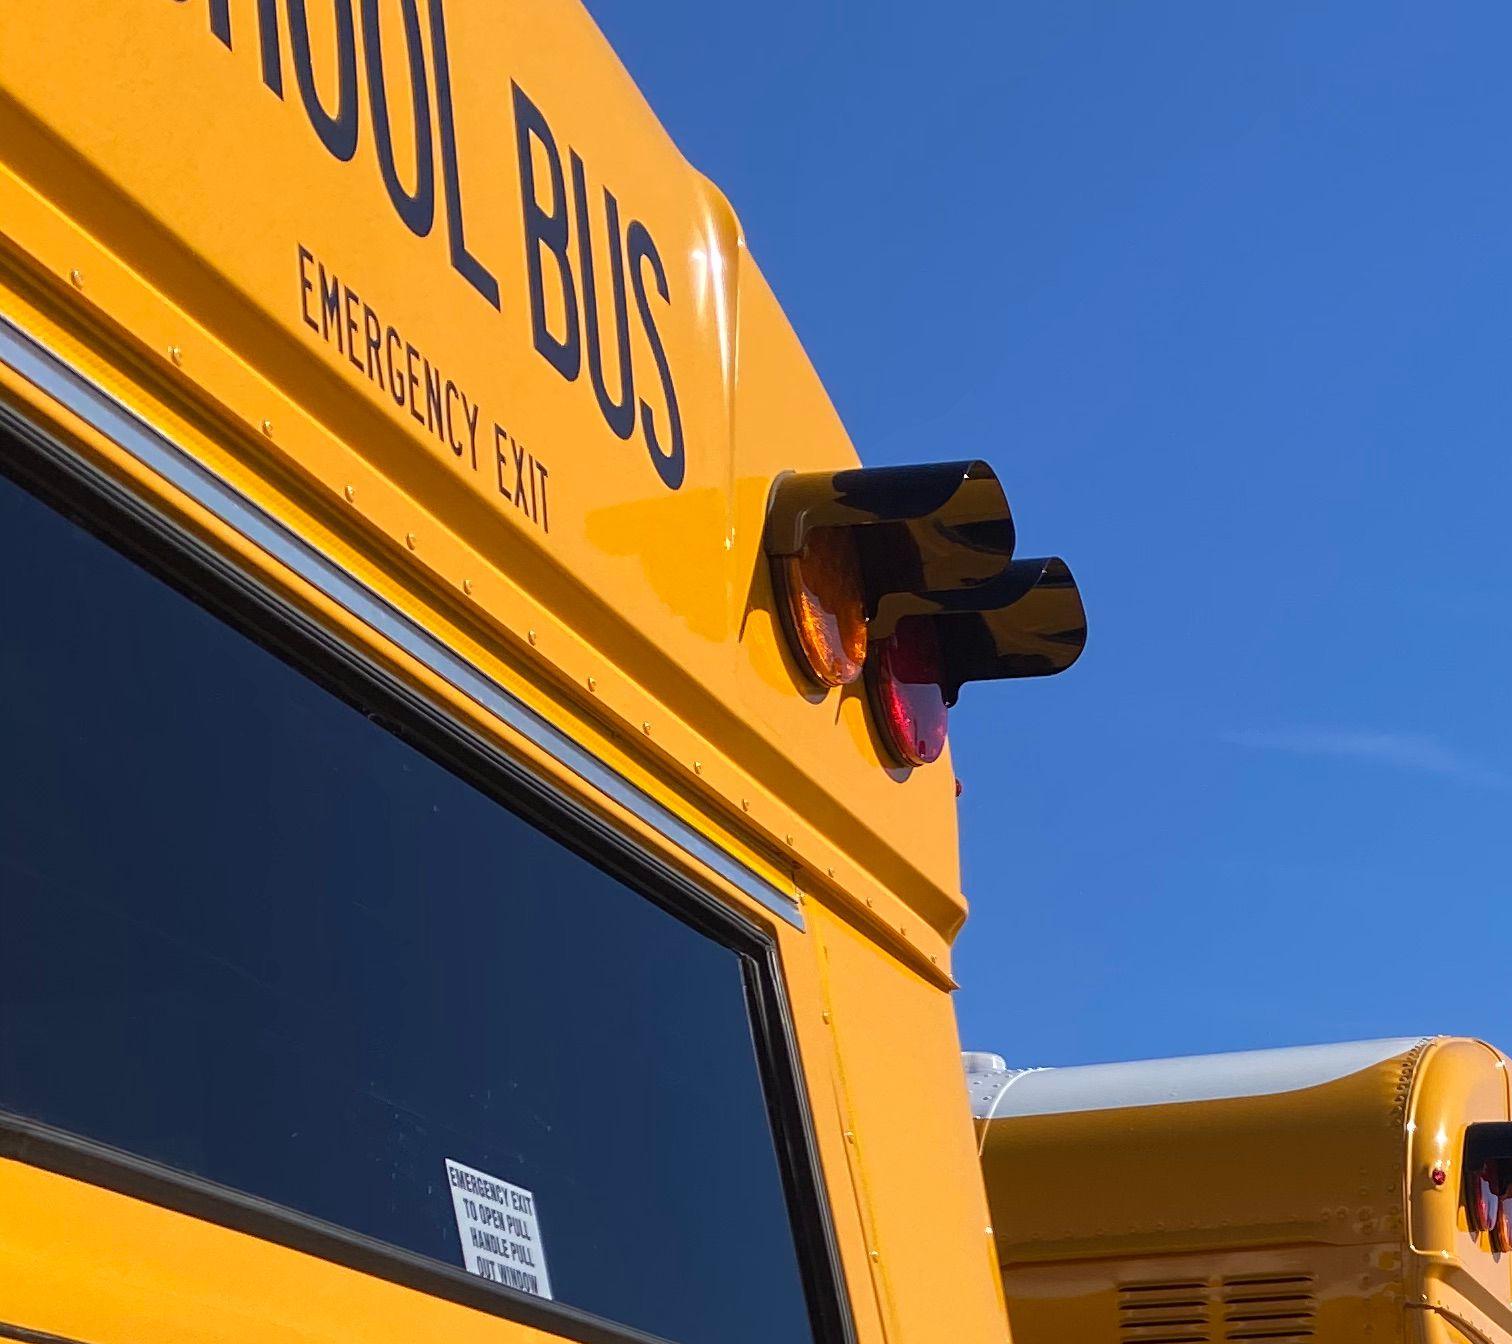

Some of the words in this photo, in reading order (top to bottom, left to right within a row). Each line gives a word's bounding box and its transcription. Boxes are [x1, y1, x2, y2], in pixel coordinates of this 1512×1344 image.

[510, 77, 686, 491] BUS
[298, 241, 480, 472] EMERGENCY
[494, 421, 550, 534] EXIT
[449, 1166, 509, 1208] EMERGENCY
[511, 1190, 533, 1217] EXIT
[463, 1197, 478, 1222] TO
[478, 1202, 506, 1232] OPEN
[506, 1214, 532, 1241] PULL
[470, 1226, 510, 1259] HANDLE
[510, 1239, 535, 1268] PULL
[476, 1255, 496, 1282] OUT
[497, 1262, 539, 1294] WINDOW
